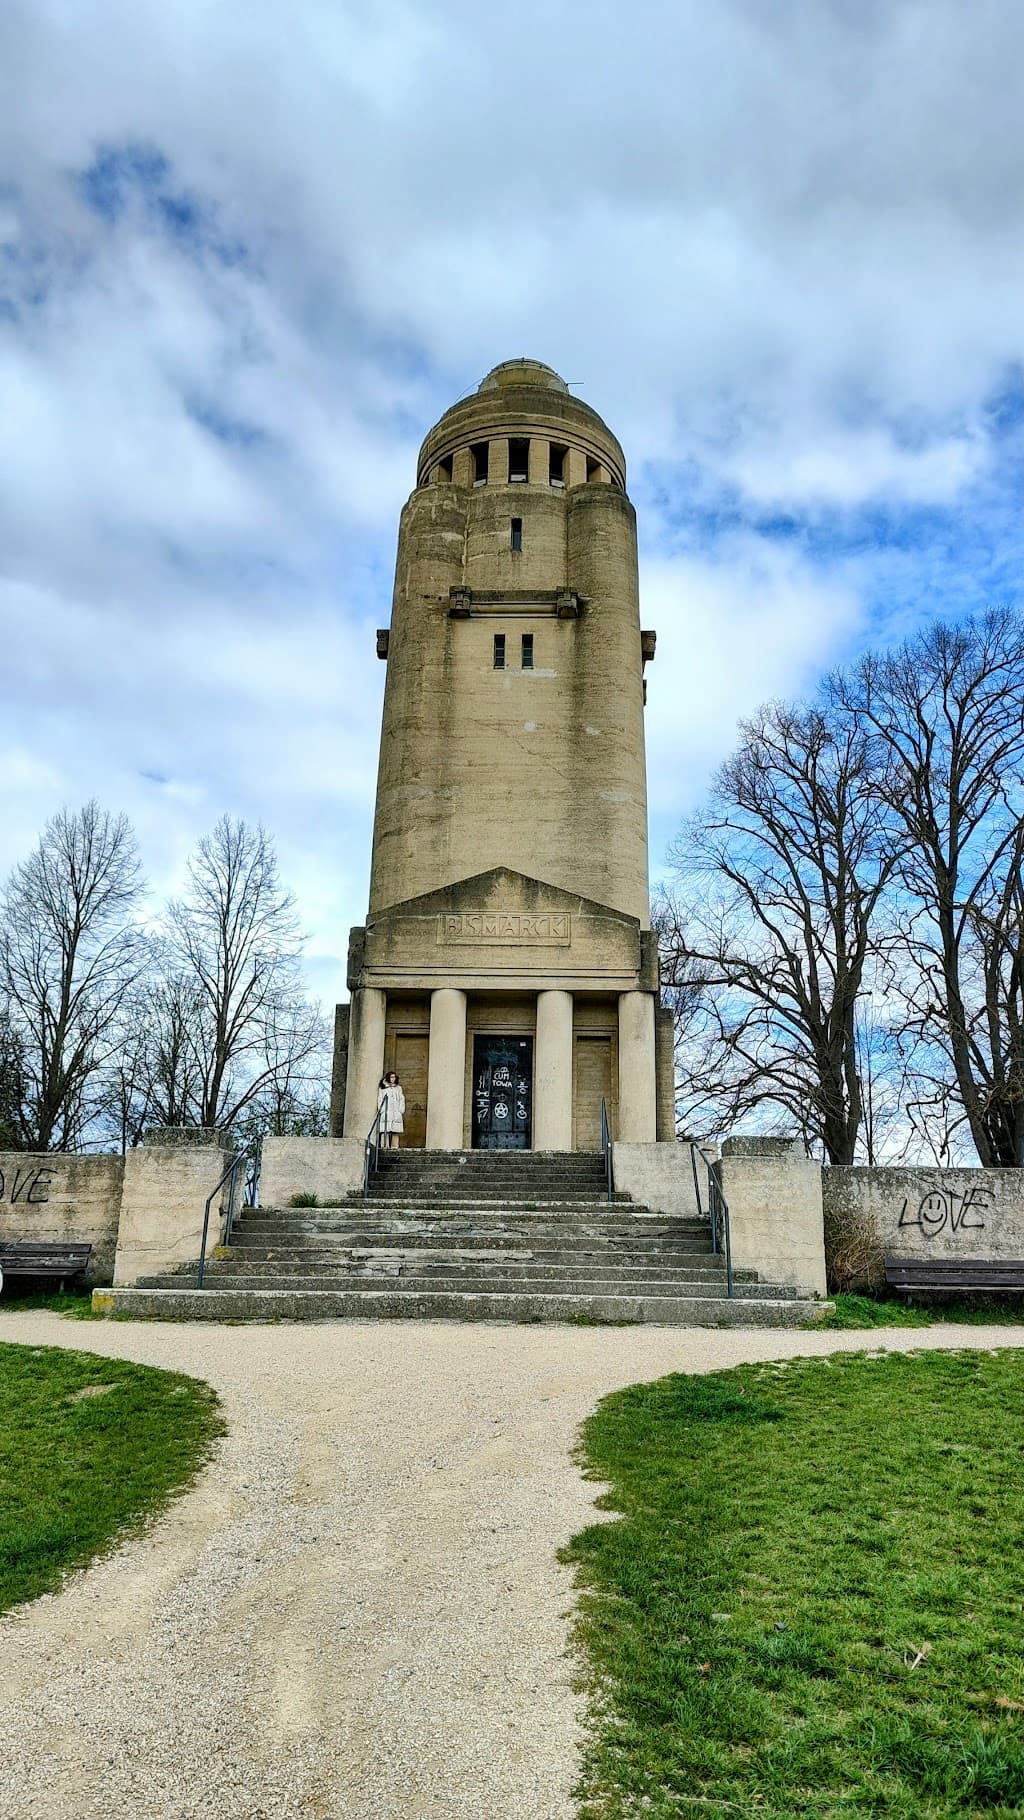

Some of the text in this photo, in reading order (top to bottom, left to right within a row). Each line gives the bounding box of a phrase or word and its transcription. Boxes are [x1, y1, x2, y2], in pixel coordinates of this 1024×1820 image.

[446, 916, 567, 936] BISMARCK
[493, 1072, 510, 1080] CUM
[0, 1168, 57, 1204] VE
[898, 1188, 996, 1238] LOVE
